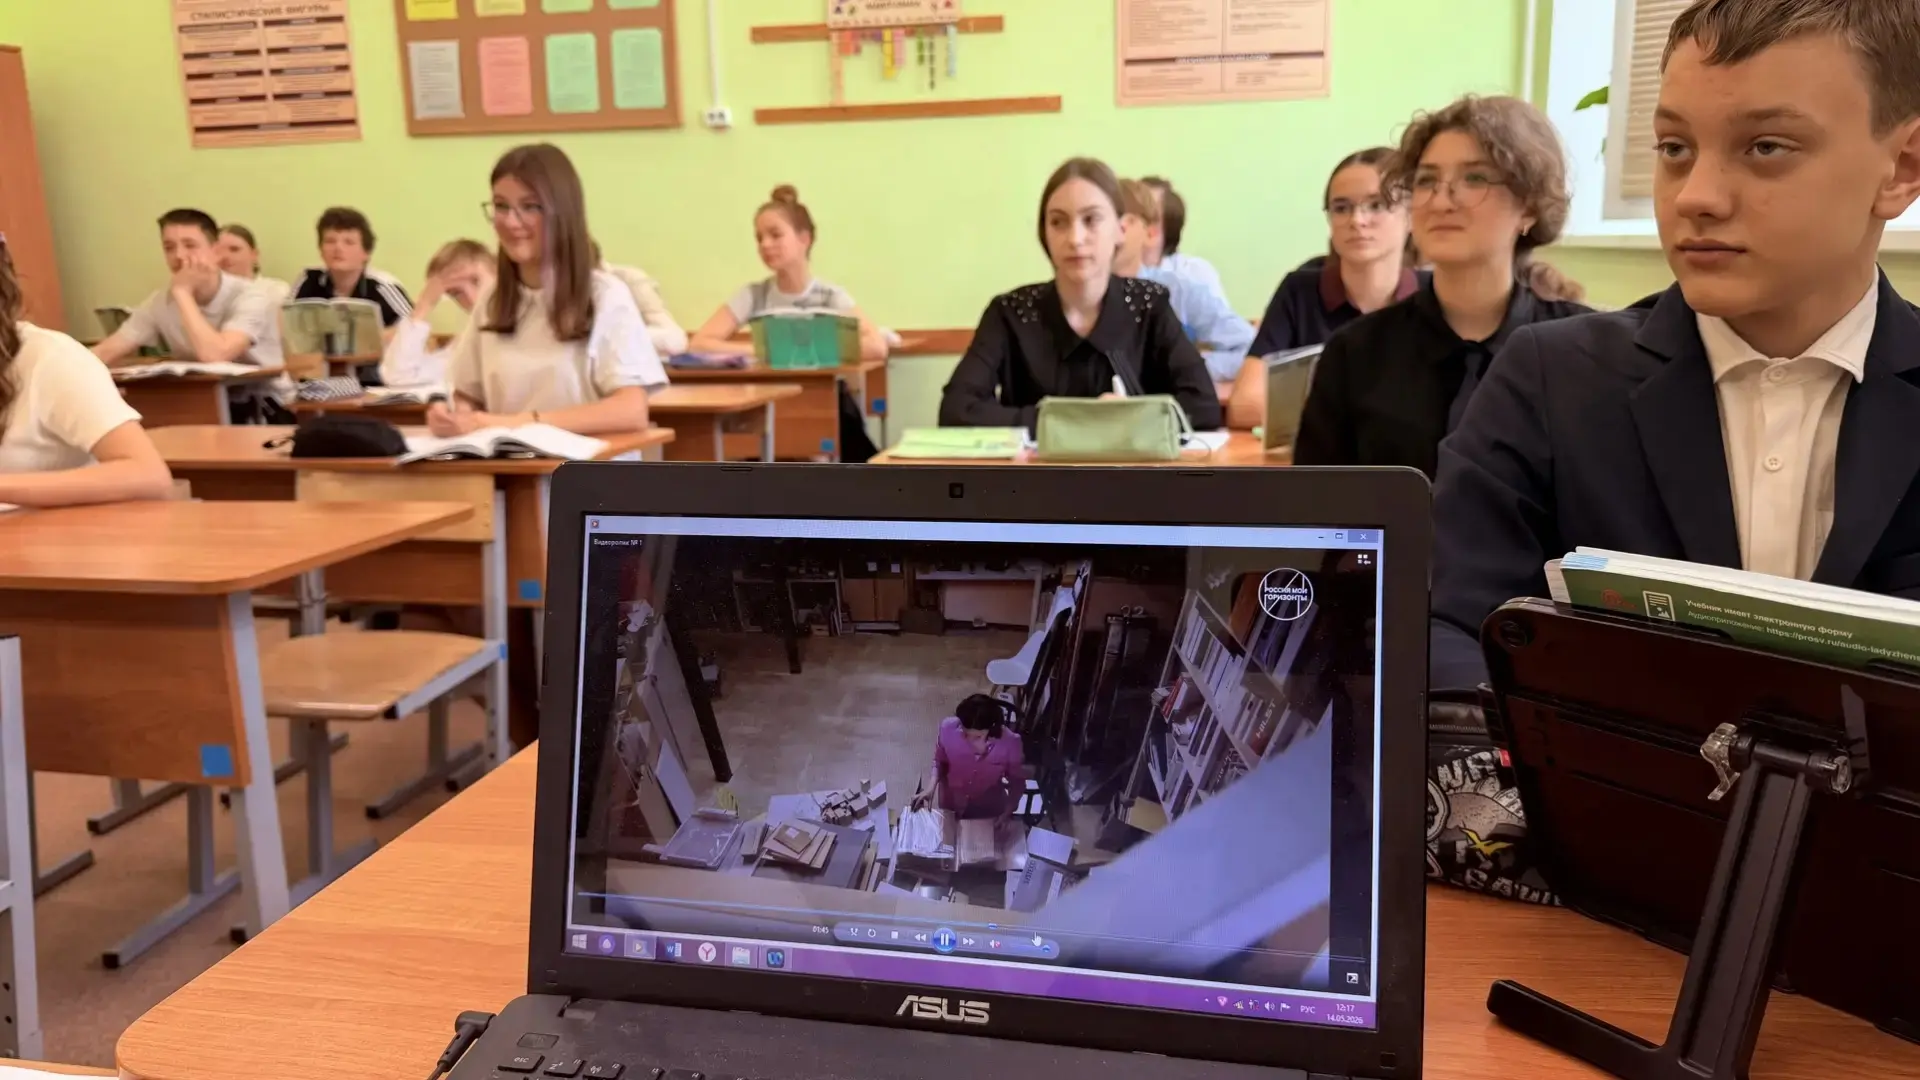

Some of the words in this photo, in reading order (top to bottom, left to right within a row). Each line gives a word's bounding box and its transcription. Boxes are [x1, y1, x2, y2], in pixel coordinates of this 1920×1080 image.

[1685, 599, 1722, 613] Учебник
[1724, 608, 1751, 619] имеет
[1753, 614, 1816, 632] электронную
[1818, 625, 1853, 639] форму
[1687, 610, 1765, 633] Аудиоприложение:
[812, 925, 829, 934] 01:45
[896, 995, 990, 1024] ASUS
[1300, 1005, 1316, 1014] РУС
[1336, 1003, 1355, 1012] 12:17
